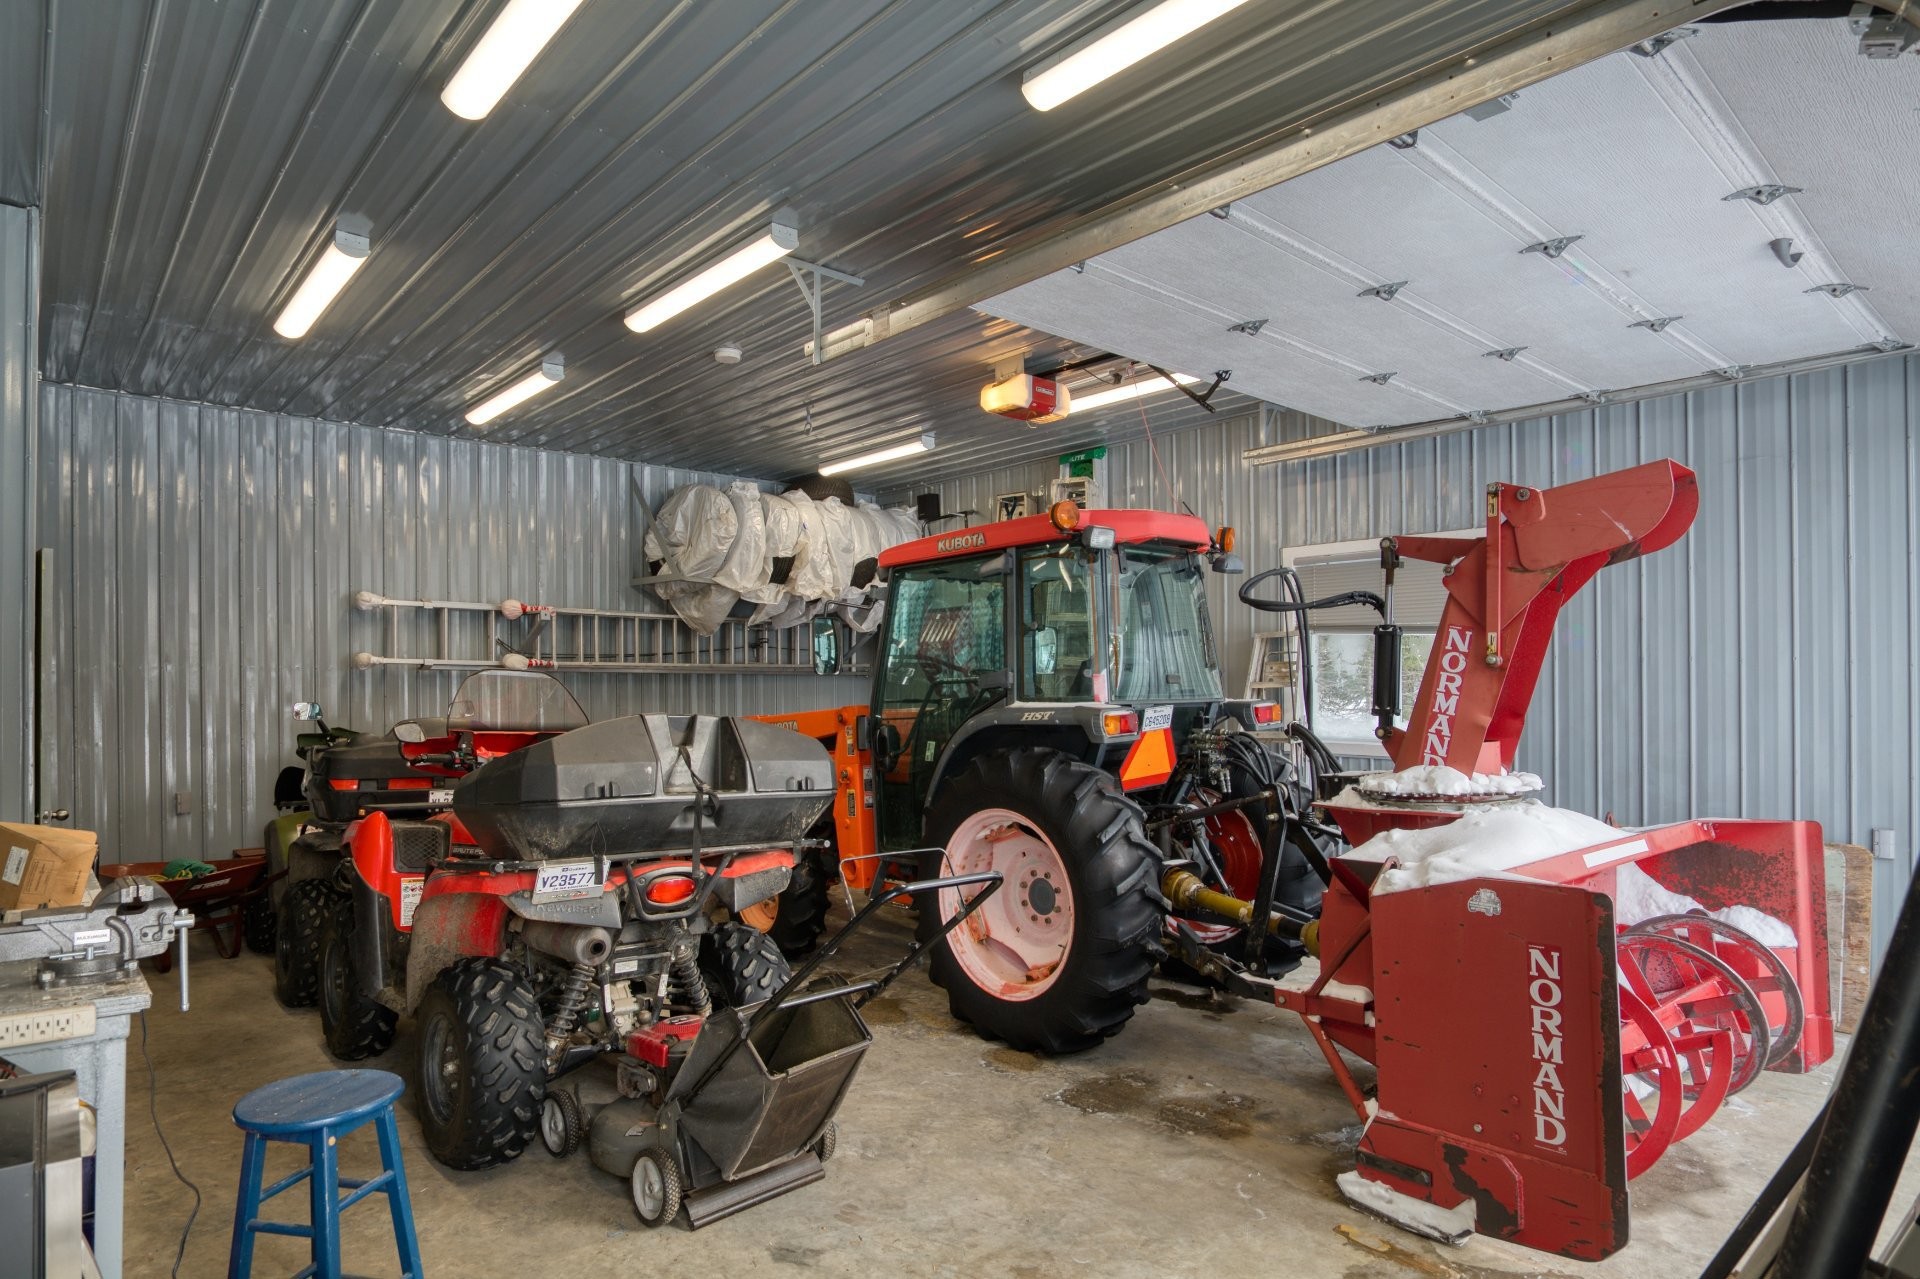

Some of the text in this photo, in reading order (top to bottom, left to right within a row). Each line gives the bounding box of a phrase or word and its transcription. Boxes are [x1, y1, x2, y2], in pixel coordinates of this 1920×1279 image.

[937, 533, 986, 553] KUBOTA
[1020, 711, 1056, 721] HST
[1528, 948, 1567, 1146] NORMAND
